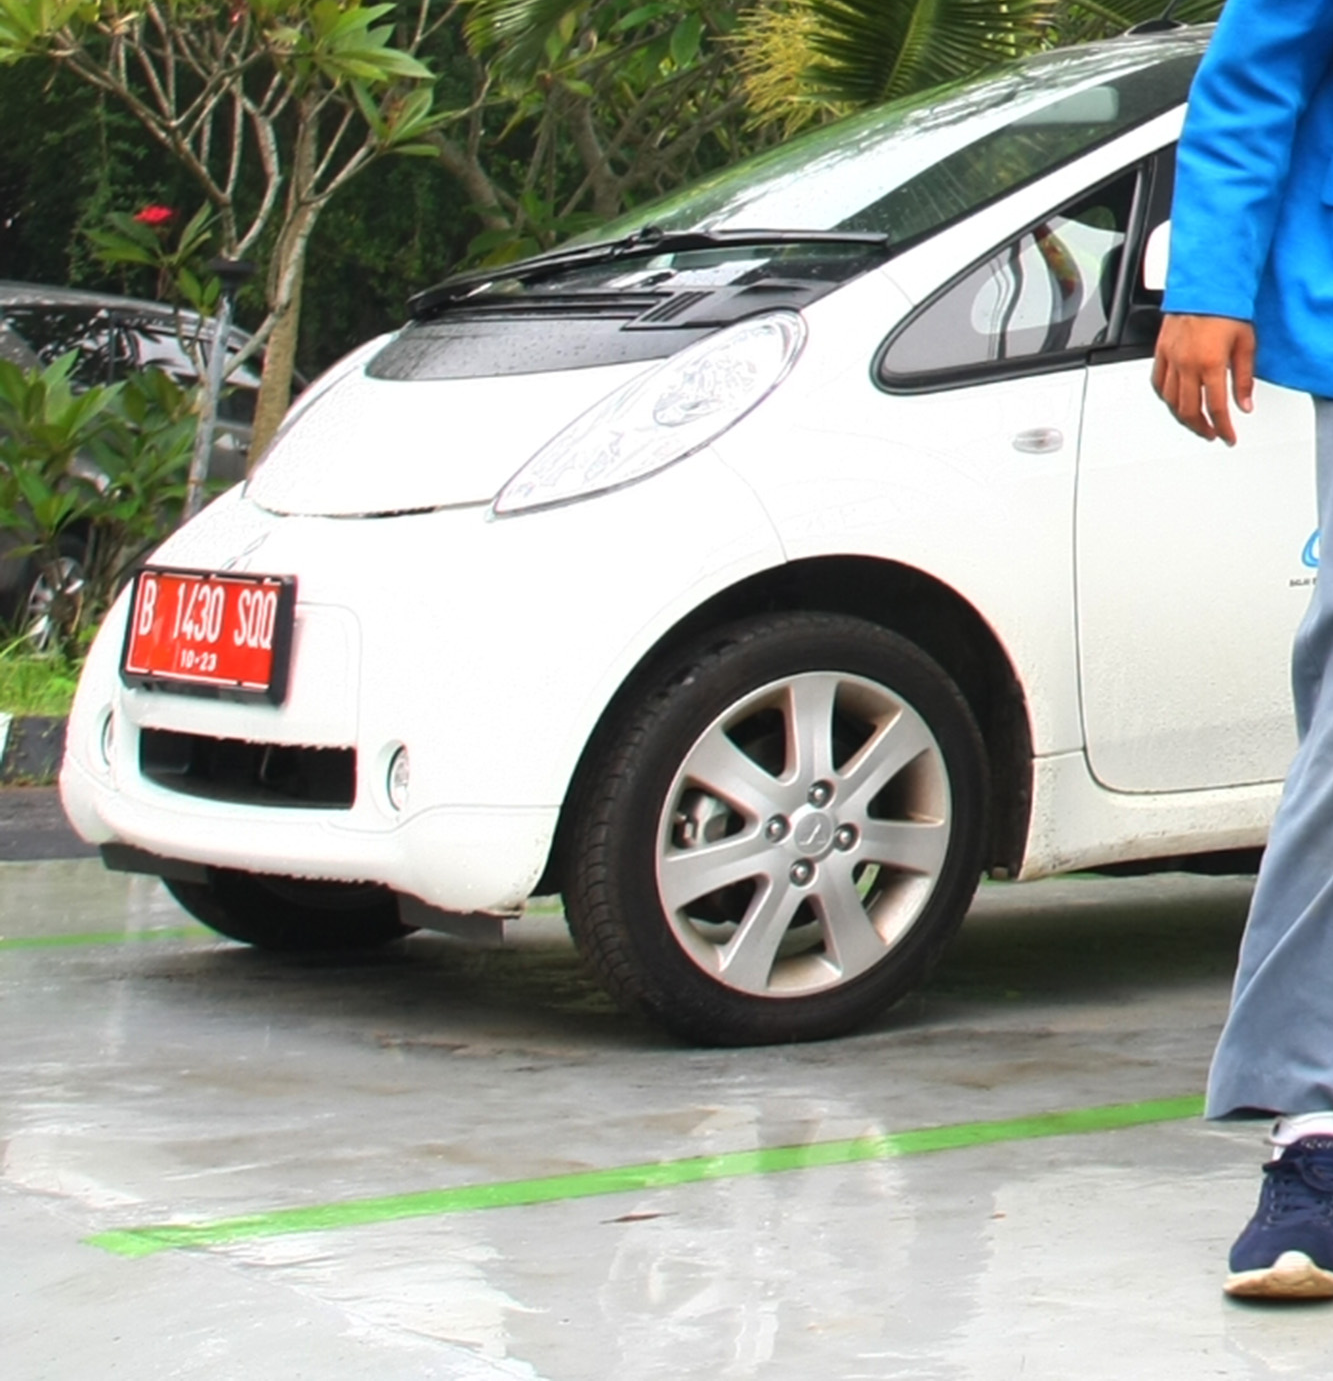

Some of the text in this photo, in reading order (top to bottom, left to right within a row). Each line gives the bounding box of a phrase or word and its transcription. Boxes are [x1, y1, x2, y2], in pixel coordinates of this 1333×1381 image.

[139, 579, 277, 649] B 1430 SQQ
